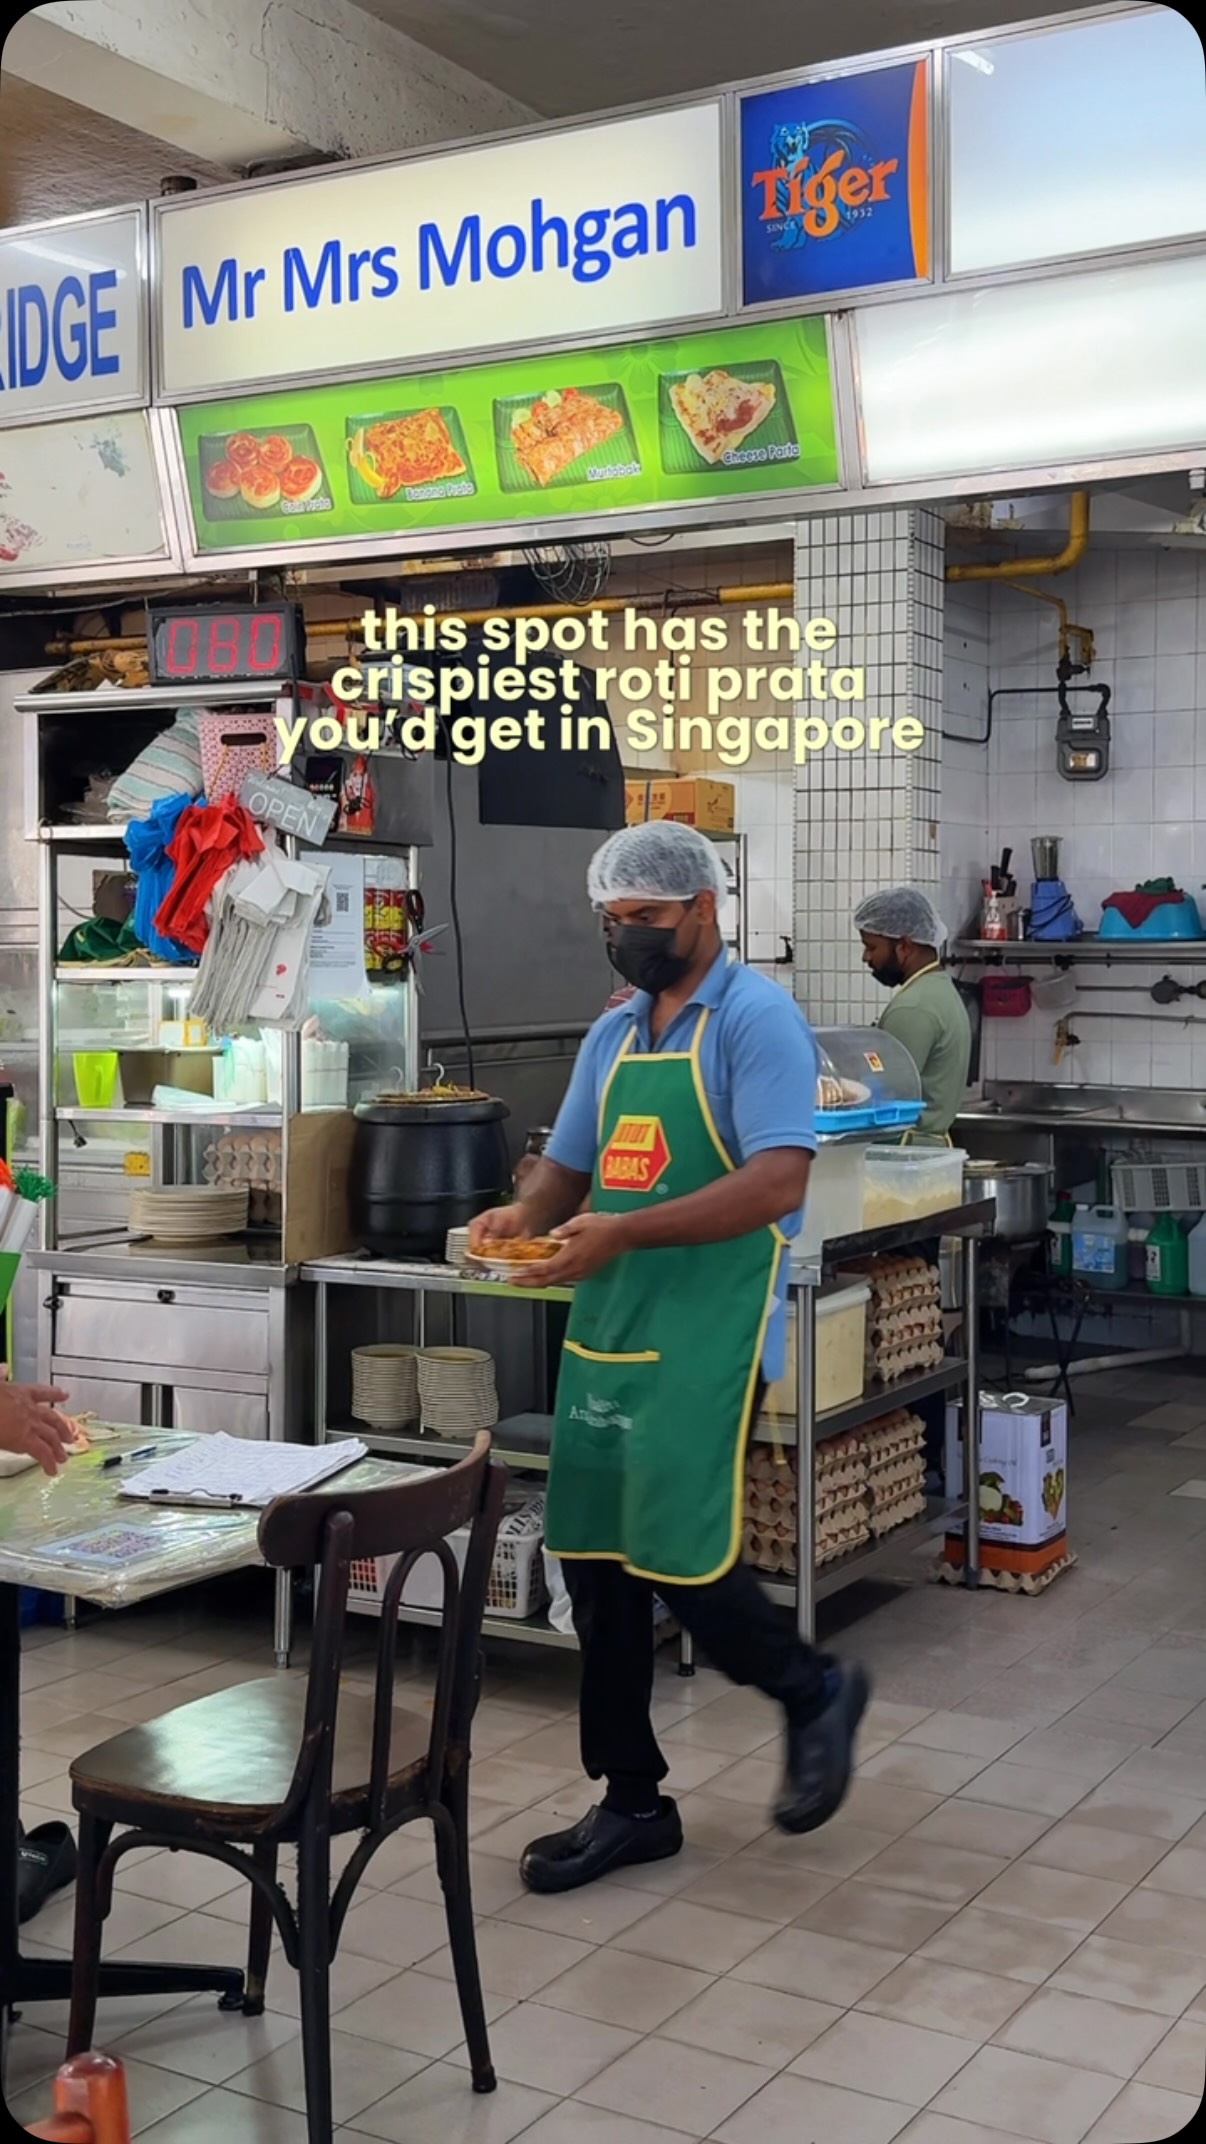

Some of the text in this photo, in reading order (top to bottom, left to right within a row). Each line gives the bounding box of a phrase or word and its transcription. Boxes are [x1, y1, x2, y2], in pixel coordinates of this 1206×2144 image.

[752, 149, 899, 238] Tiger
[766, 207, 873, 234] SINCE 1932
[182, 194, 697, 329] Mr Mrs Mohgan
[0, 269, 120, 392] IDGE
[587, 462, 641, 481] Murtabak
[722, 448, 767, 466] Cheese
[406, 487, 446, 501] Banana
[166, 613, 282, 675] 080
[248, 791, 318, 837] OPEN
